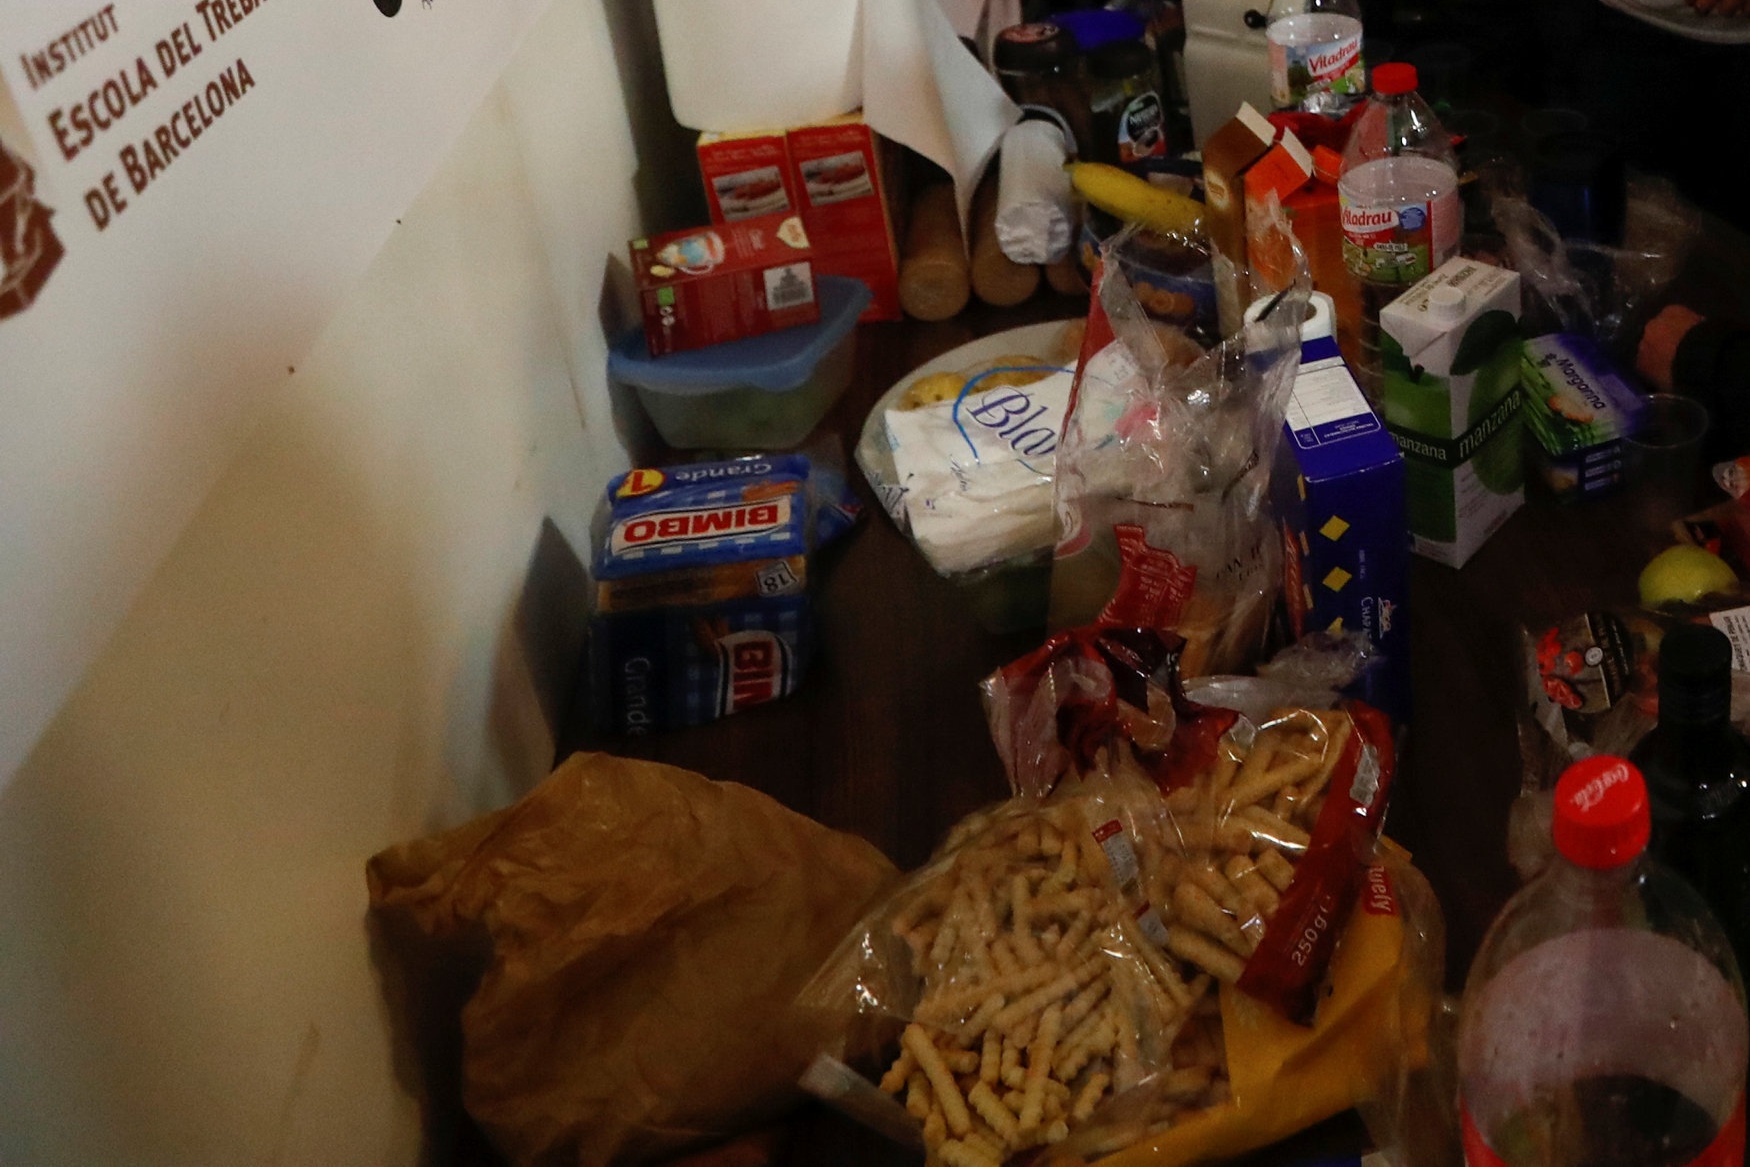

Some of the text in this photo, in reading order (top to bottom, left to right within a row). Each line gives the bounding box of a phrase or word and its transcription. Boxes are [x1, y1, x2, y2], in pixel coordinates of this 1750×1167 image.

[20, 3, 119, 91] INSTITUT
[1308, 37, 1359, 74] Viladrau
[47, 56, 159, 163] ESCOLA
[155, 22, 203, 79] DEL
[84, 57, 256, 232] DE BARCELONA
[1557, 358, 1606, 410] Margarina
[1458, 390, 1522, 458] manzana
[675, 462, 773, 482] Grande
[623, 504, 779, 544] BIMBO
[763, 567, 790, 592] 18
[1291, 913, 1328, 967] 250 g
